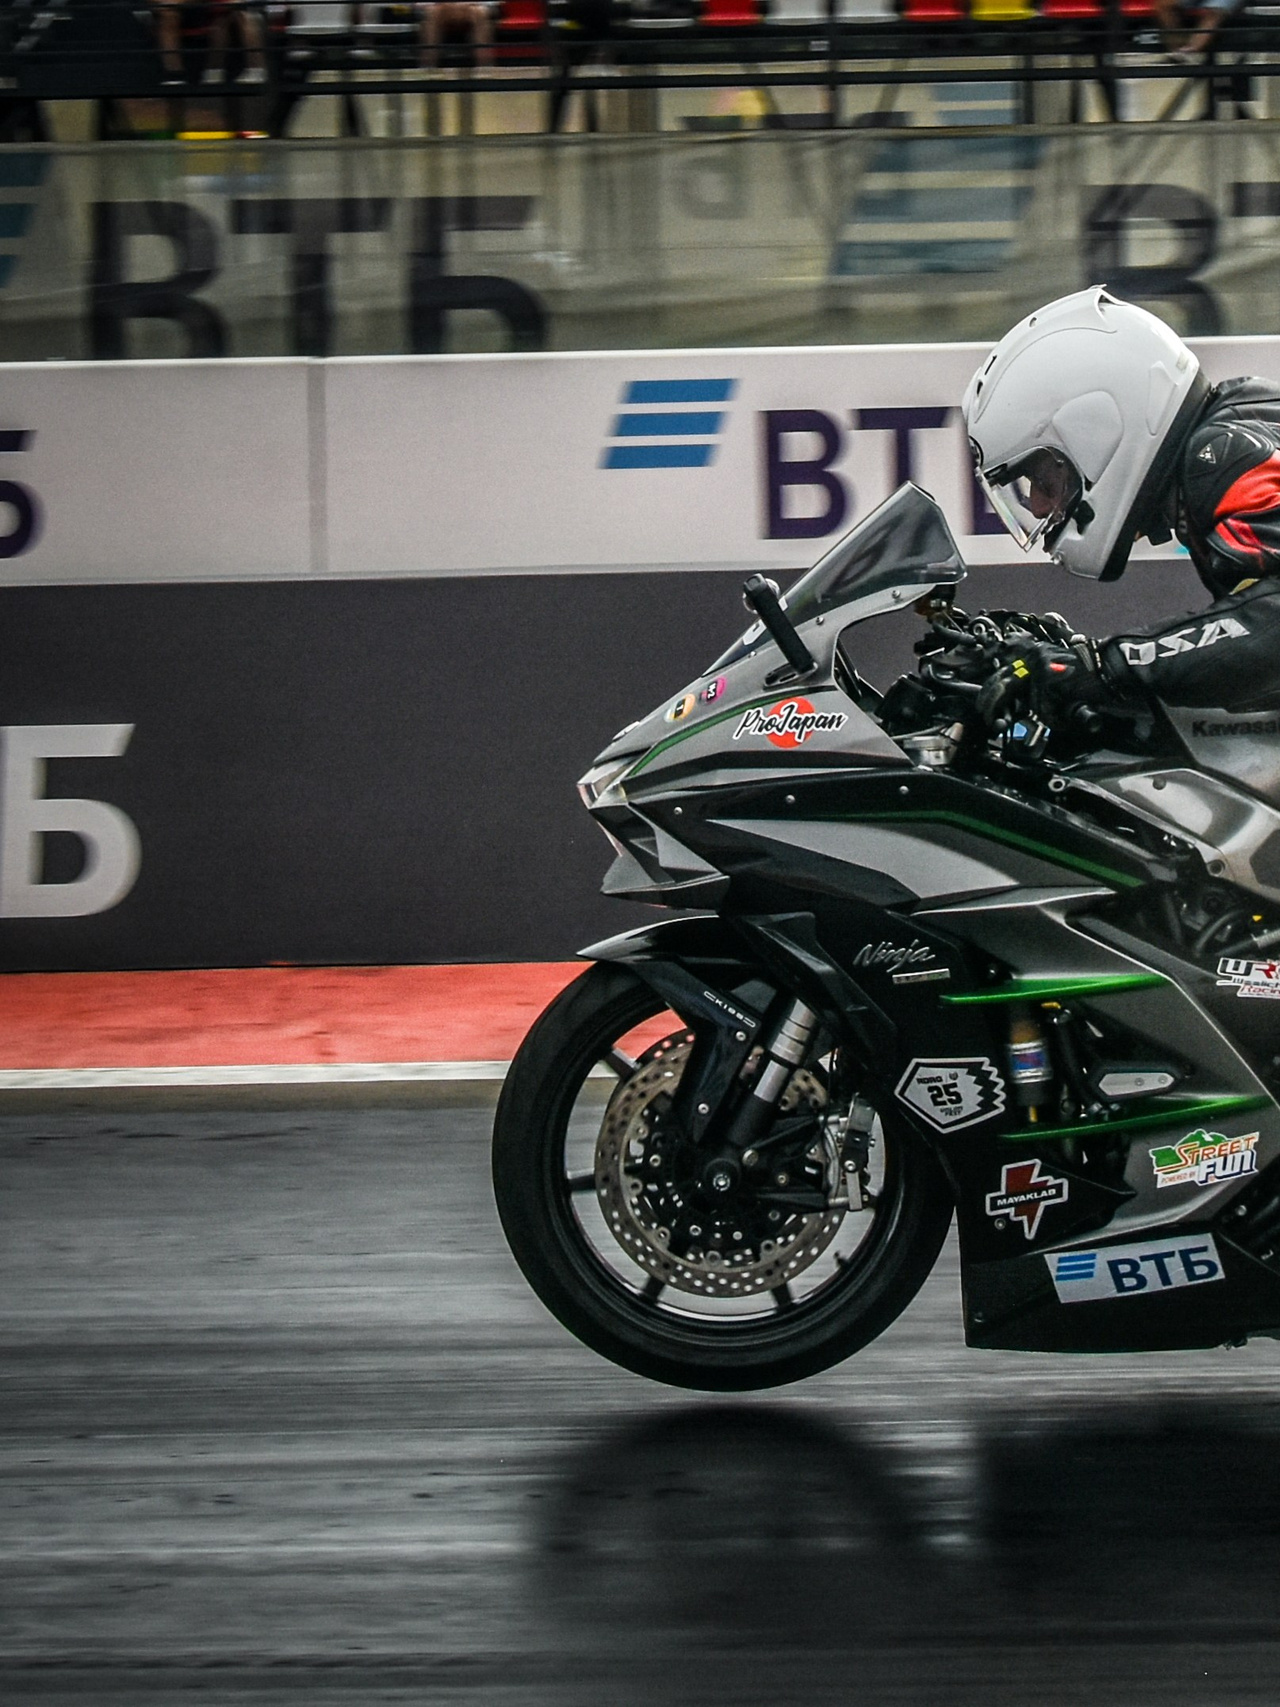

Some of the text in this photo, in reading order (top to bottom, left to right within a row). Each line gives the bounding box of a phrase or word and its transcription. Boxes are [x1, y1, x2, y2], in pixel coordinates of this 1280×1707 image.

[733, 701, 848, 742] ProJapan
[852, 938, 936, 973] Ninja
[927, 1082, 963, 1107] 25
[1155, 1136, 1257, 1173] STREET
[997, 1188, 1057, 1207] MAYAKLAB
[1106, 1245, 1219, 1294] ВТБ
